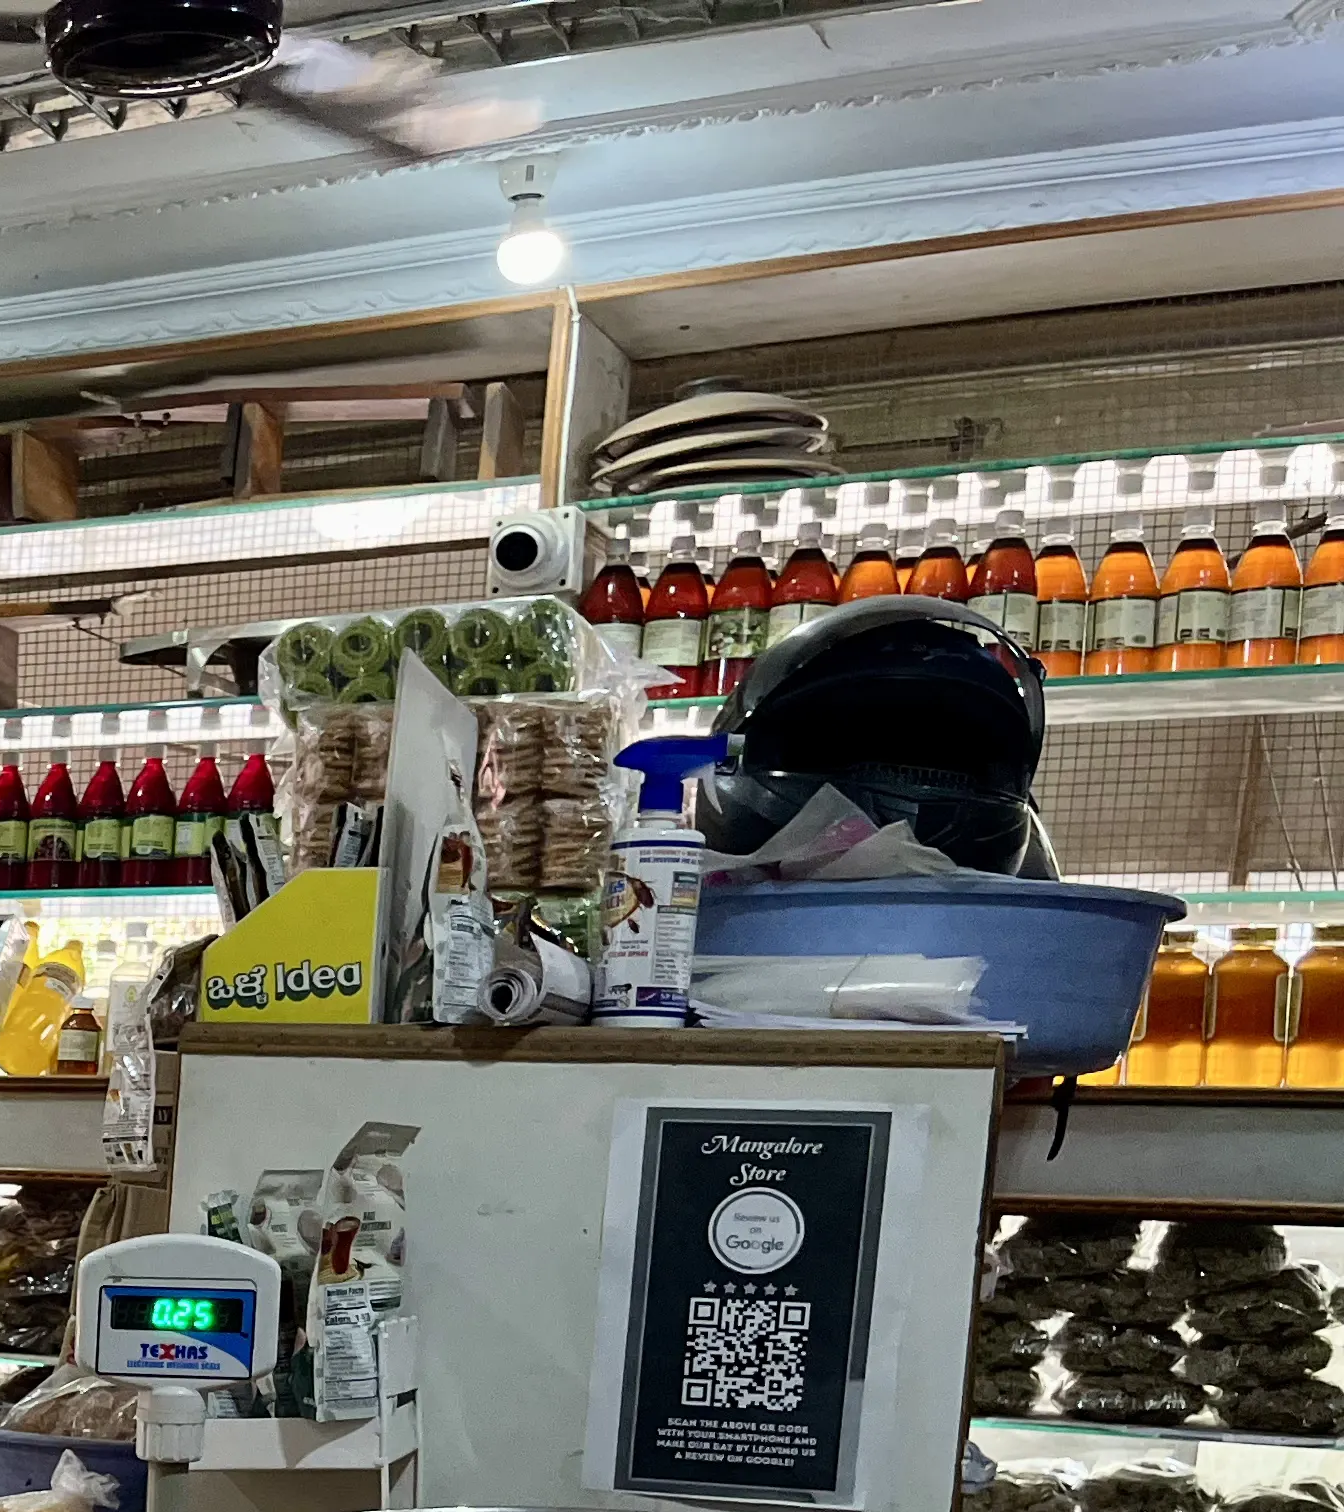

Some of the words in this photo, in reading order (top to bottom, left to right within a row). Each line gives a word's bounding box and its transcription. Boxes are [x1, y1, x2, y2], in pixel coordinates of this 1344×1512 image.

[275, 960, 361, 998] Idea
[700, 1135, 823, 1160] Mangalore
[729, 1163, 787, 1186] Store
[725, 1235, 784, 1254] Google
[153, 1298, 213, 1330] 0.25
[140, 1344, 208, 1360] TEXHAS
